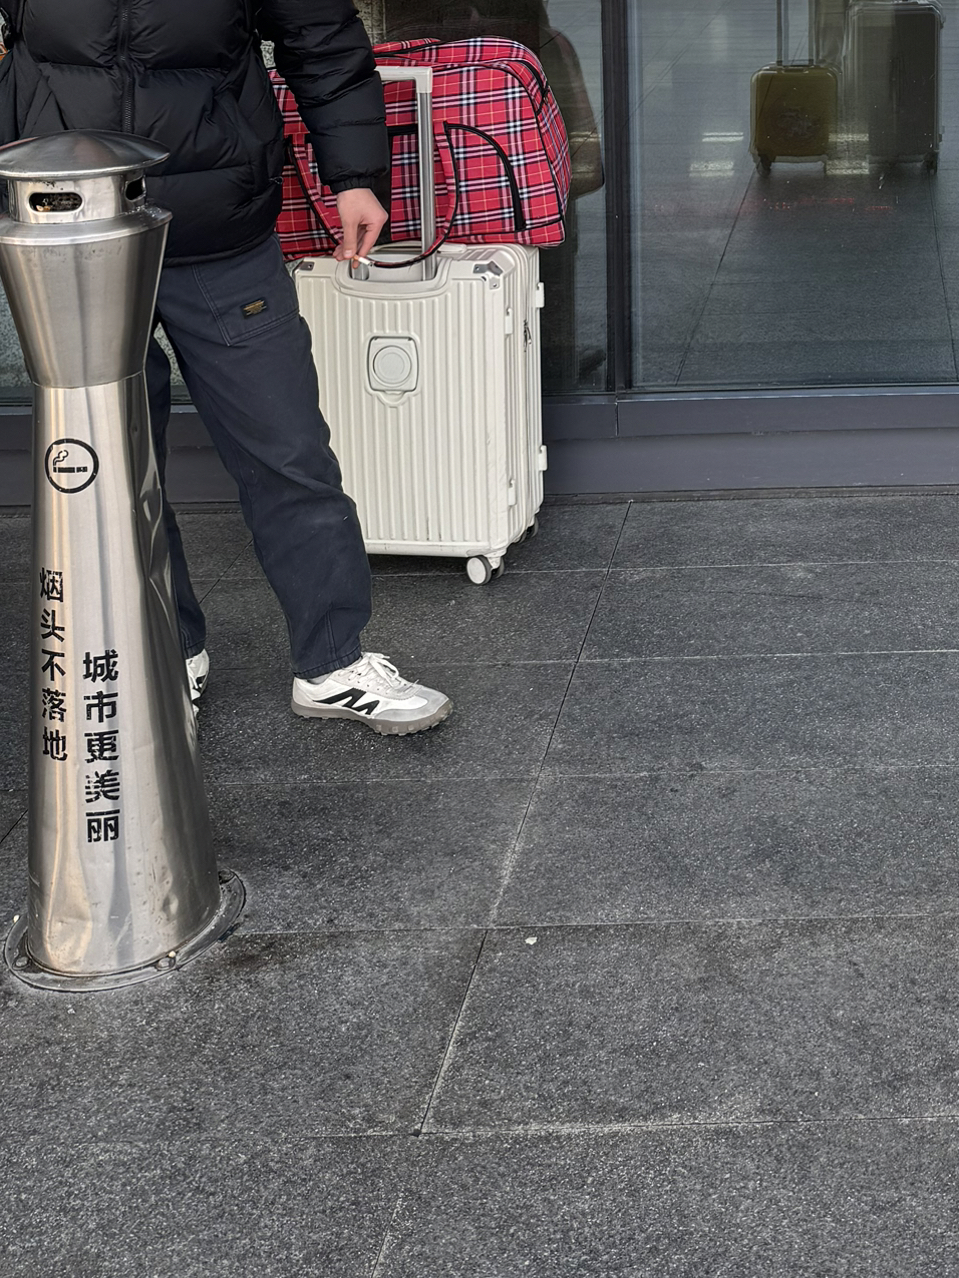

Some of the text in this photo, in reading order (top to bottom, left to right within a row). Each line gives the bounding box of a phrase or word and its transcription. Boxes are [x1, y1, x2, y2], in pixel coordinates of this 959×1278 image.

[39, 567, 67, 762] 烟头不落地
[82, 649, 120, 844] 城市更美丽
